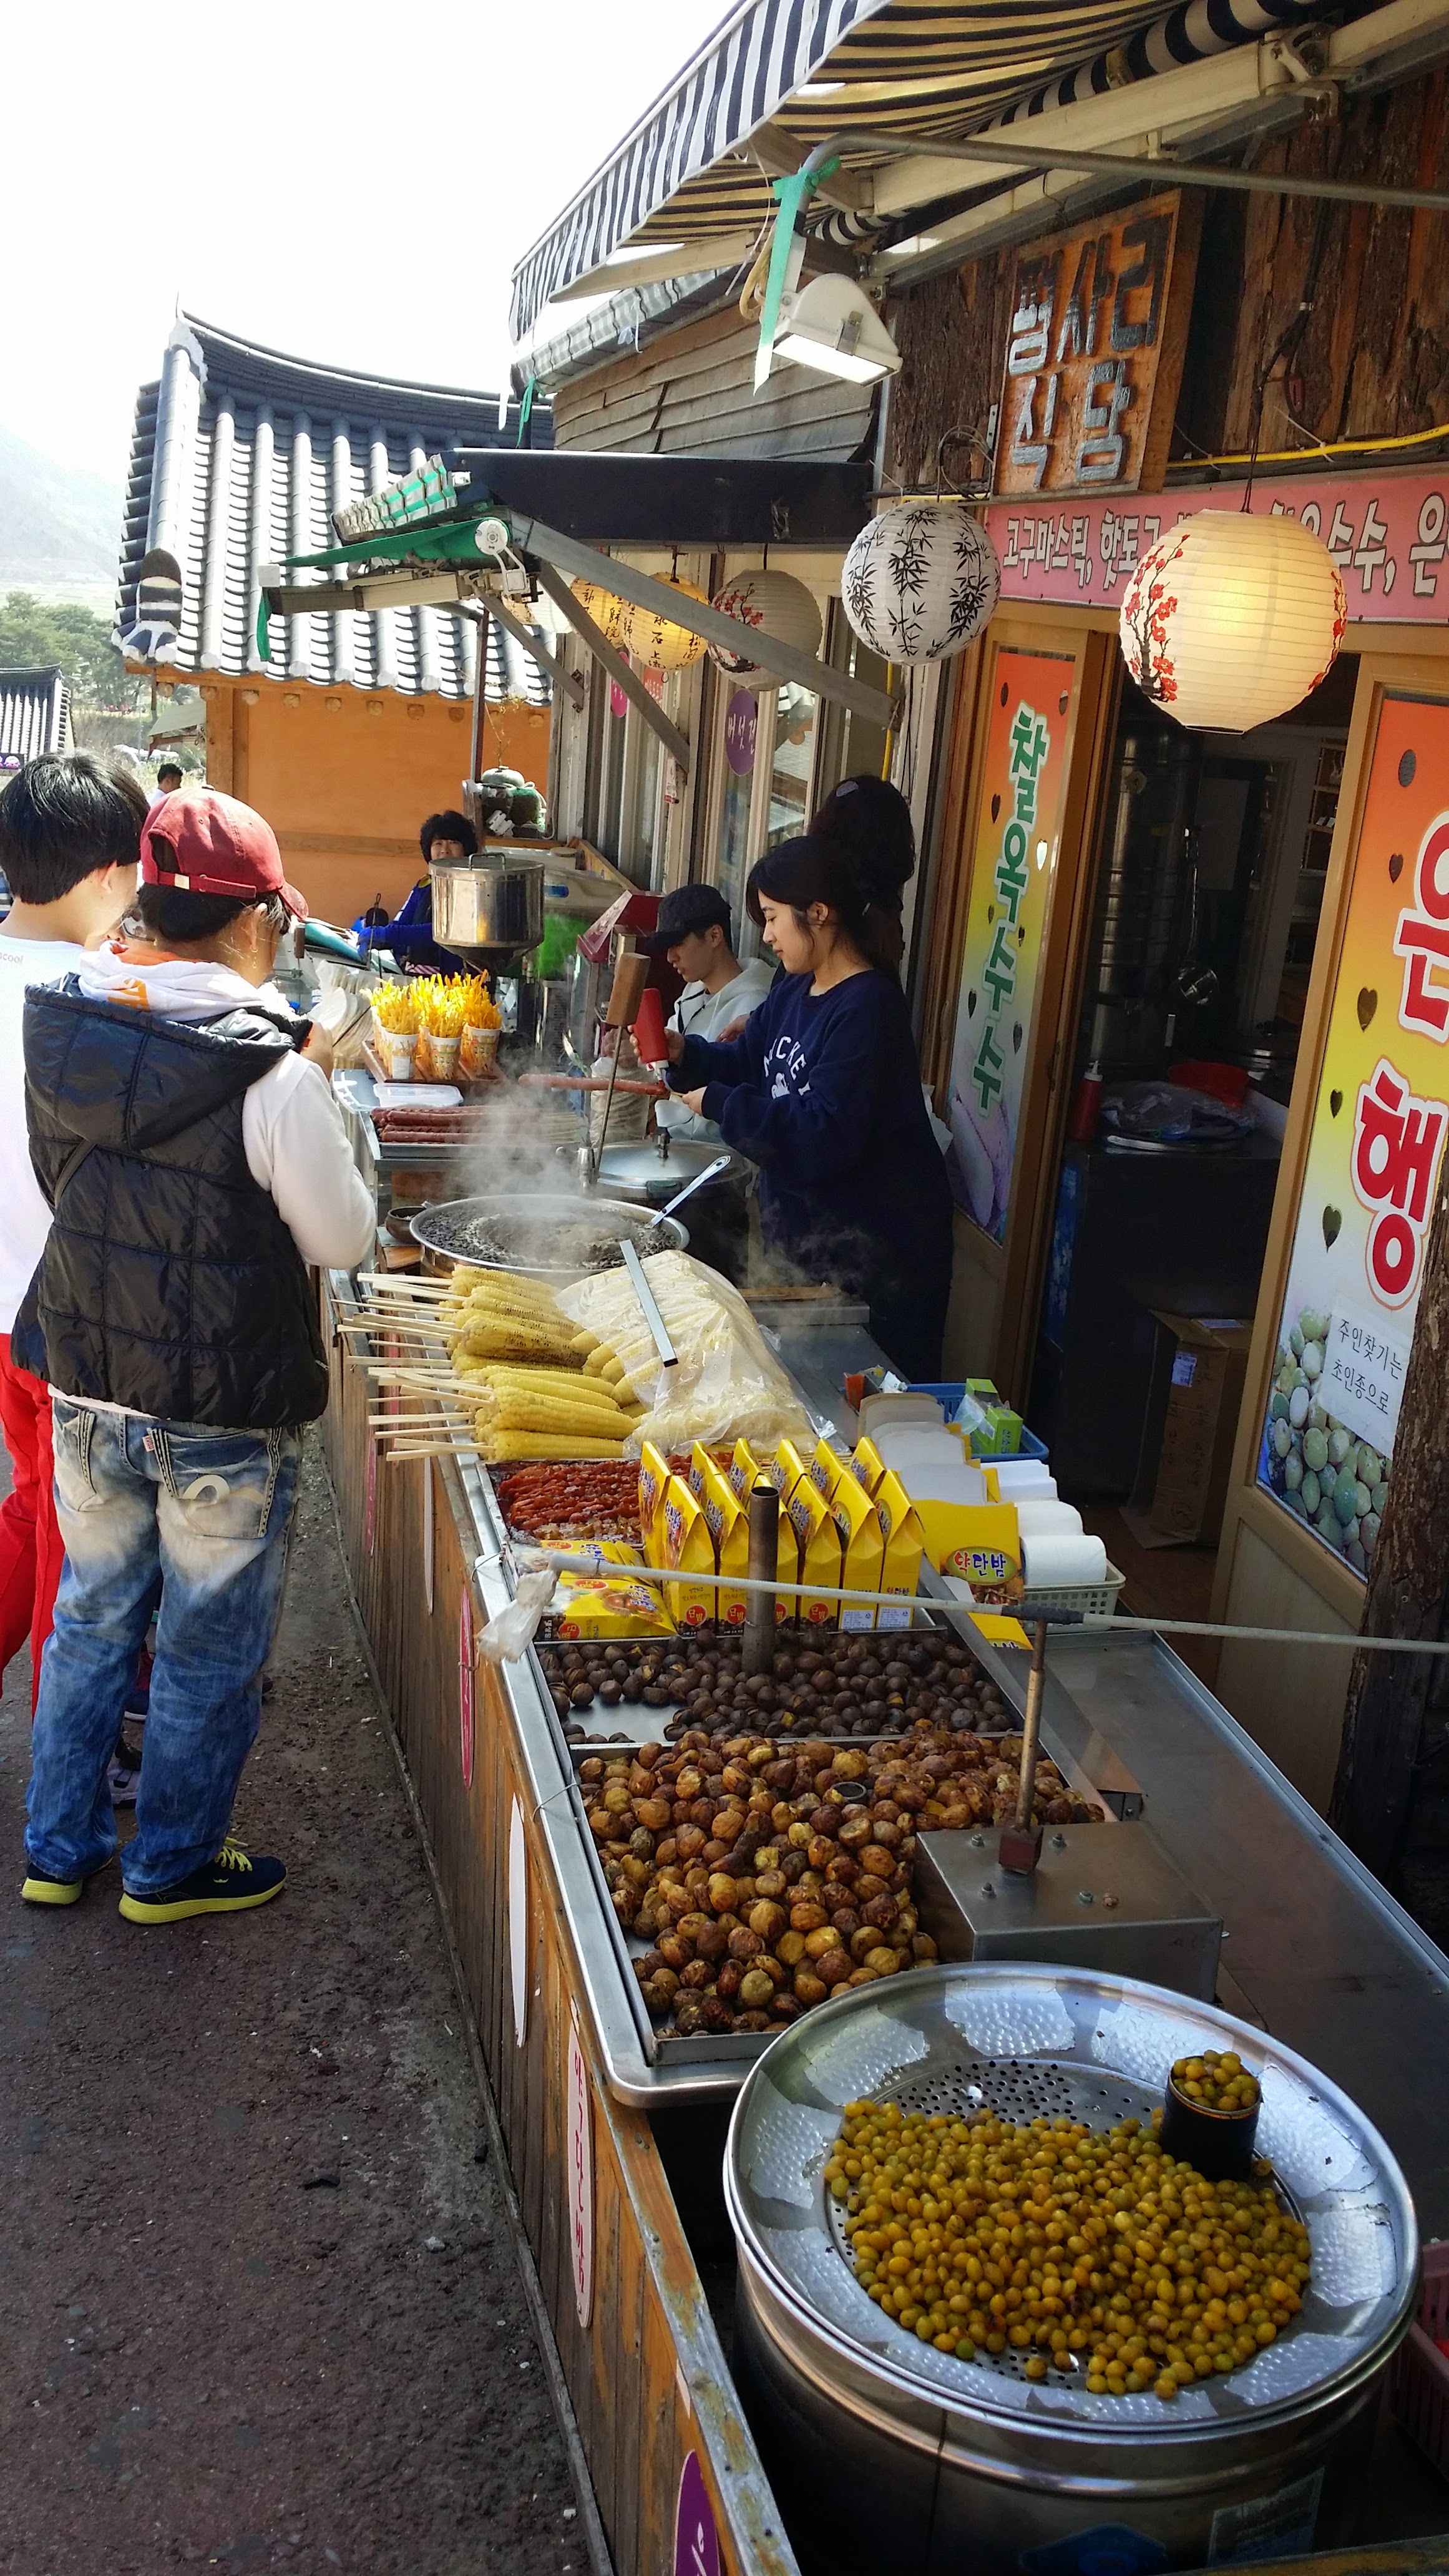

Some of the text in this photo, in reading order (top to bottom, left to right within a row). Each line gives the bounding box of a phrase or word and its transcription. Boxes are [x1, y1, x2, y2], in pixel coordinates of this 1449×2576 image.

[1012, 358, 1130, 488] 식당
[1003, 512, 1093, 588] 고구마스틱,
[1409, 490, 1449, 597] 은
[972, 705, 1048, 1114] 찰옥수수
[1331, 1359, 1388, 1415] 초인종으로
[1339, 1319, 1402, 1379] 주인찾기는
[954, 1551, 1007, 1578] 약단밤
